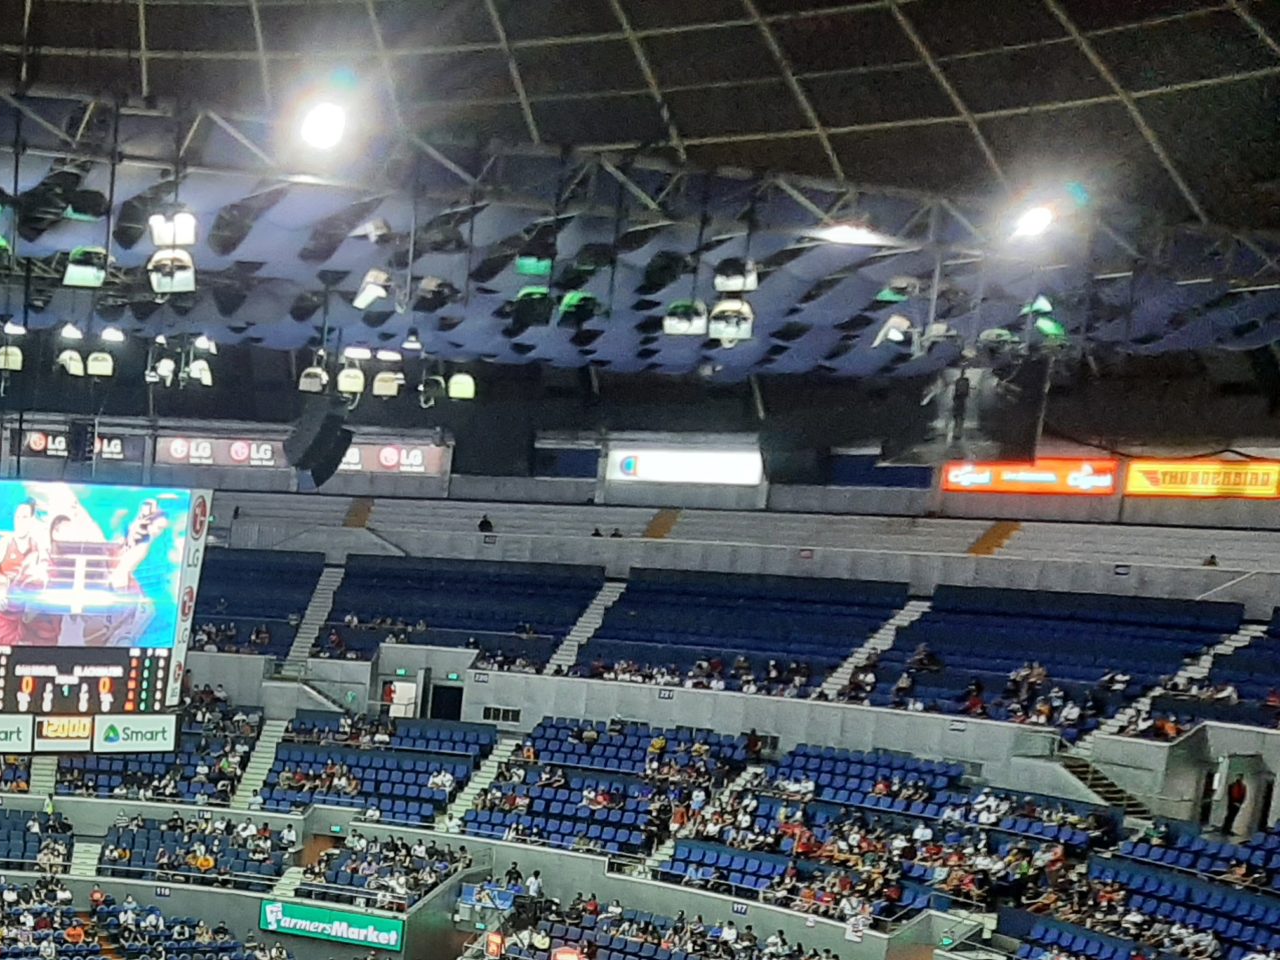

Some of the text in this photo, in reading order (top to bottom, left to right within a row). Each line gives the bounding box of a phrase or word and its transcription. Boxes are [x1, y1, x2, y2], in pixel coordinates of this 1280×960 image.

[47, 435, 67, 450] LG
[102, 439, 122, 453] LG
[189, 441, 212, 458] LG
[250, 443, 273, 459] LG
[399, 449, 424, 465] LG
[1160, 470, 1270, 487] THUNDERBIRD
[186, 547, 201, 569] LG
[121, 726, 168, 742] Smart
[732, 903, 747, 915] 117
